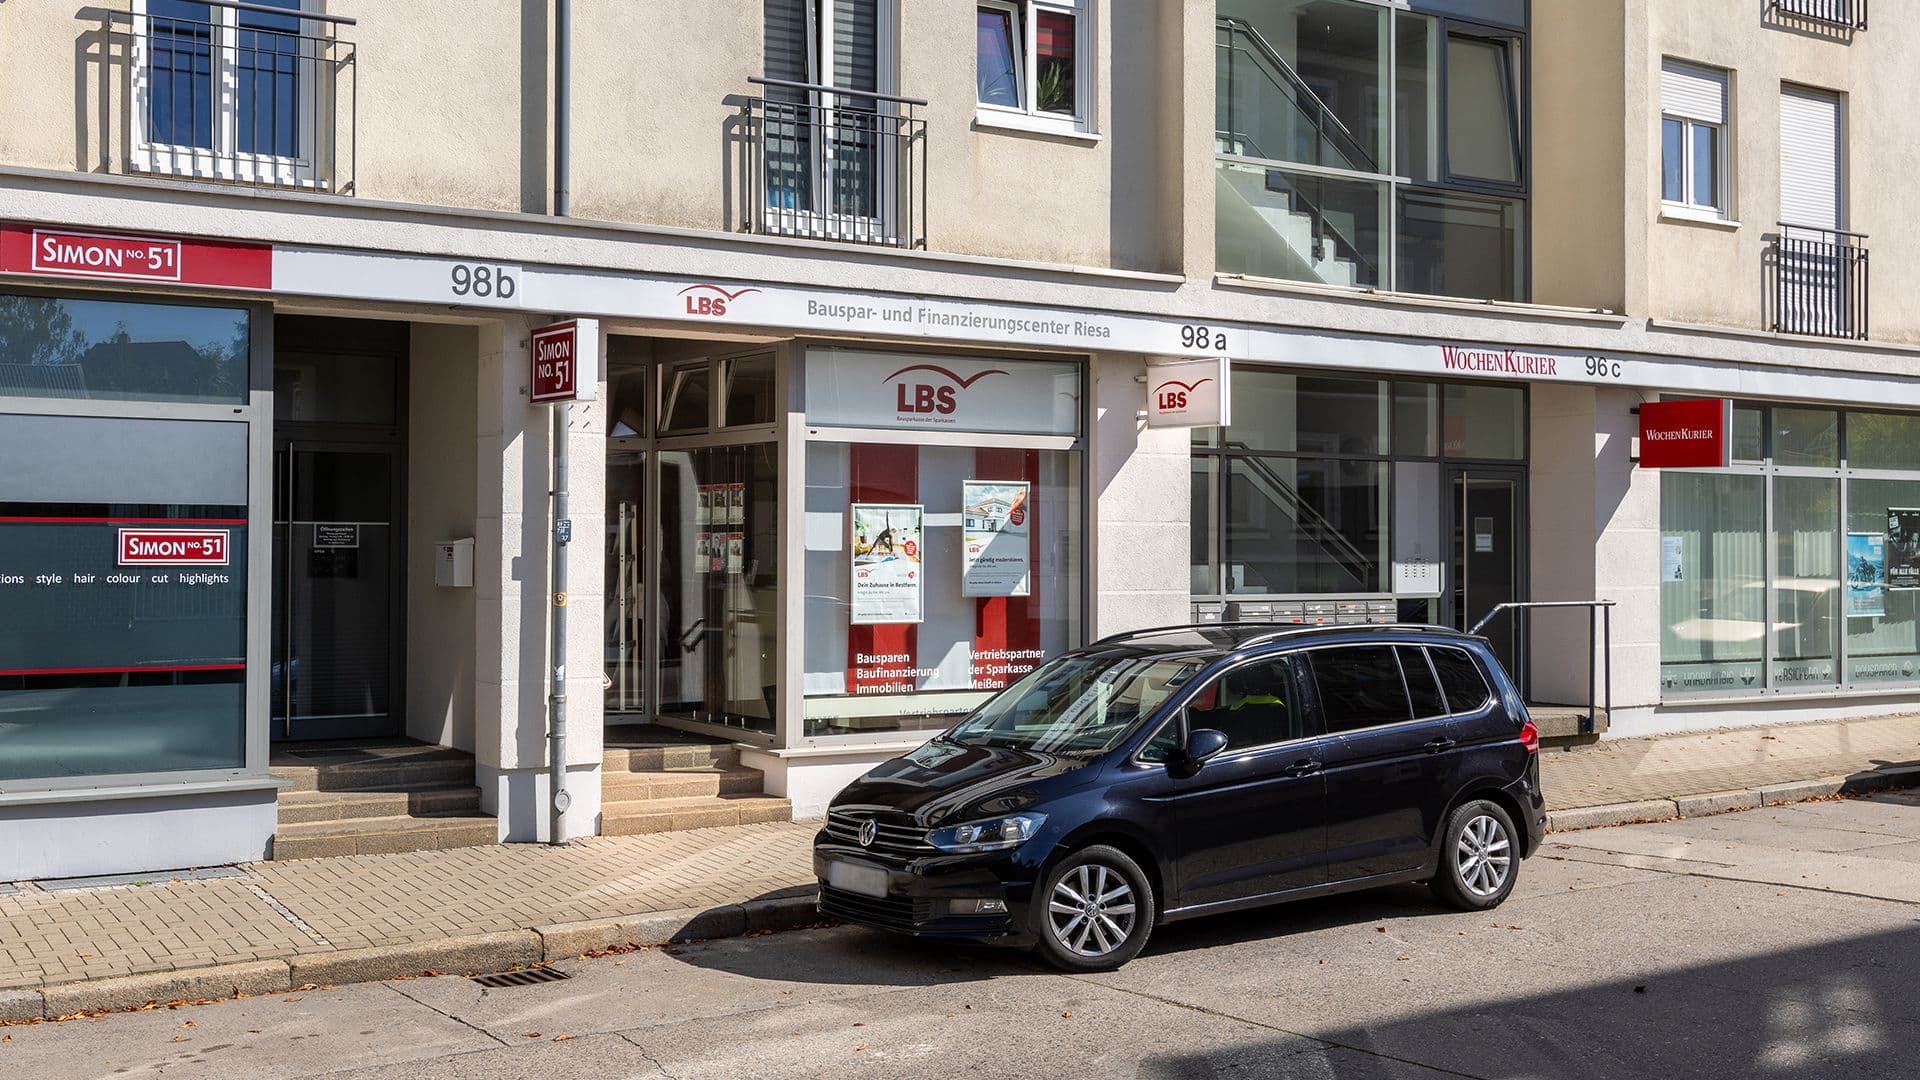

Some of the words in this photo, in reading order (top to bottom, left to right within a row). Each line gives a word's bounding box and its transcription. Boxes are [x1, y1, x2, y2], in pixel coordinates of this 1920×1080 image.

[43, 238, 122, 267] SIMON
[126, 249, 146, 260] NO.
[148, 247, 173, 269] 51
[451, 264, 515, 299] 98b
[686, 295, 726, 317] LBS
[807, 299, 877, 321] Bauspar-
[882, 306, 912, 322] und
[918, 308, 1070, 334] Finanzierungscenter
[1074, 321, 1111, 338] Riesa
[1180, 325, 1210, 349] 98
[1214, 332, 1227, 350] a
[538, 340, 569, 361] SIMON
[538, 364, 553, 378] NO.
[555, 362, 569, 389] 51
[1585, 356, 1607, 376] 96
[1611, 361, 1621, 378] c
[897, 384, 956, 414] LBS
[1159, 392, 1187, 410] LBS
[129, 537, 185, 555] SIMON
[203, 539, 221, 555] 51
[0, 574, 24, 584] ions
[36, 574, 62, 586] style
[74, 573, 95, 584] hair
[107, 573, 140, 584] colour
[152, 574, 168, 584] cut
[179, 573, 229, 586] highlights
[857, 654, 909, 664] Bausparen
[968, 649, 1045, 660] Vertriebspartner
[857, 668, 939, 679] Baufinanzierung
[968, 665, 984, 675] der
[987, 663, 1033, 675] Sparkasse
[857, 683, 913, 694] Immobilien
[968, 680, 1004, 689] Meißen
